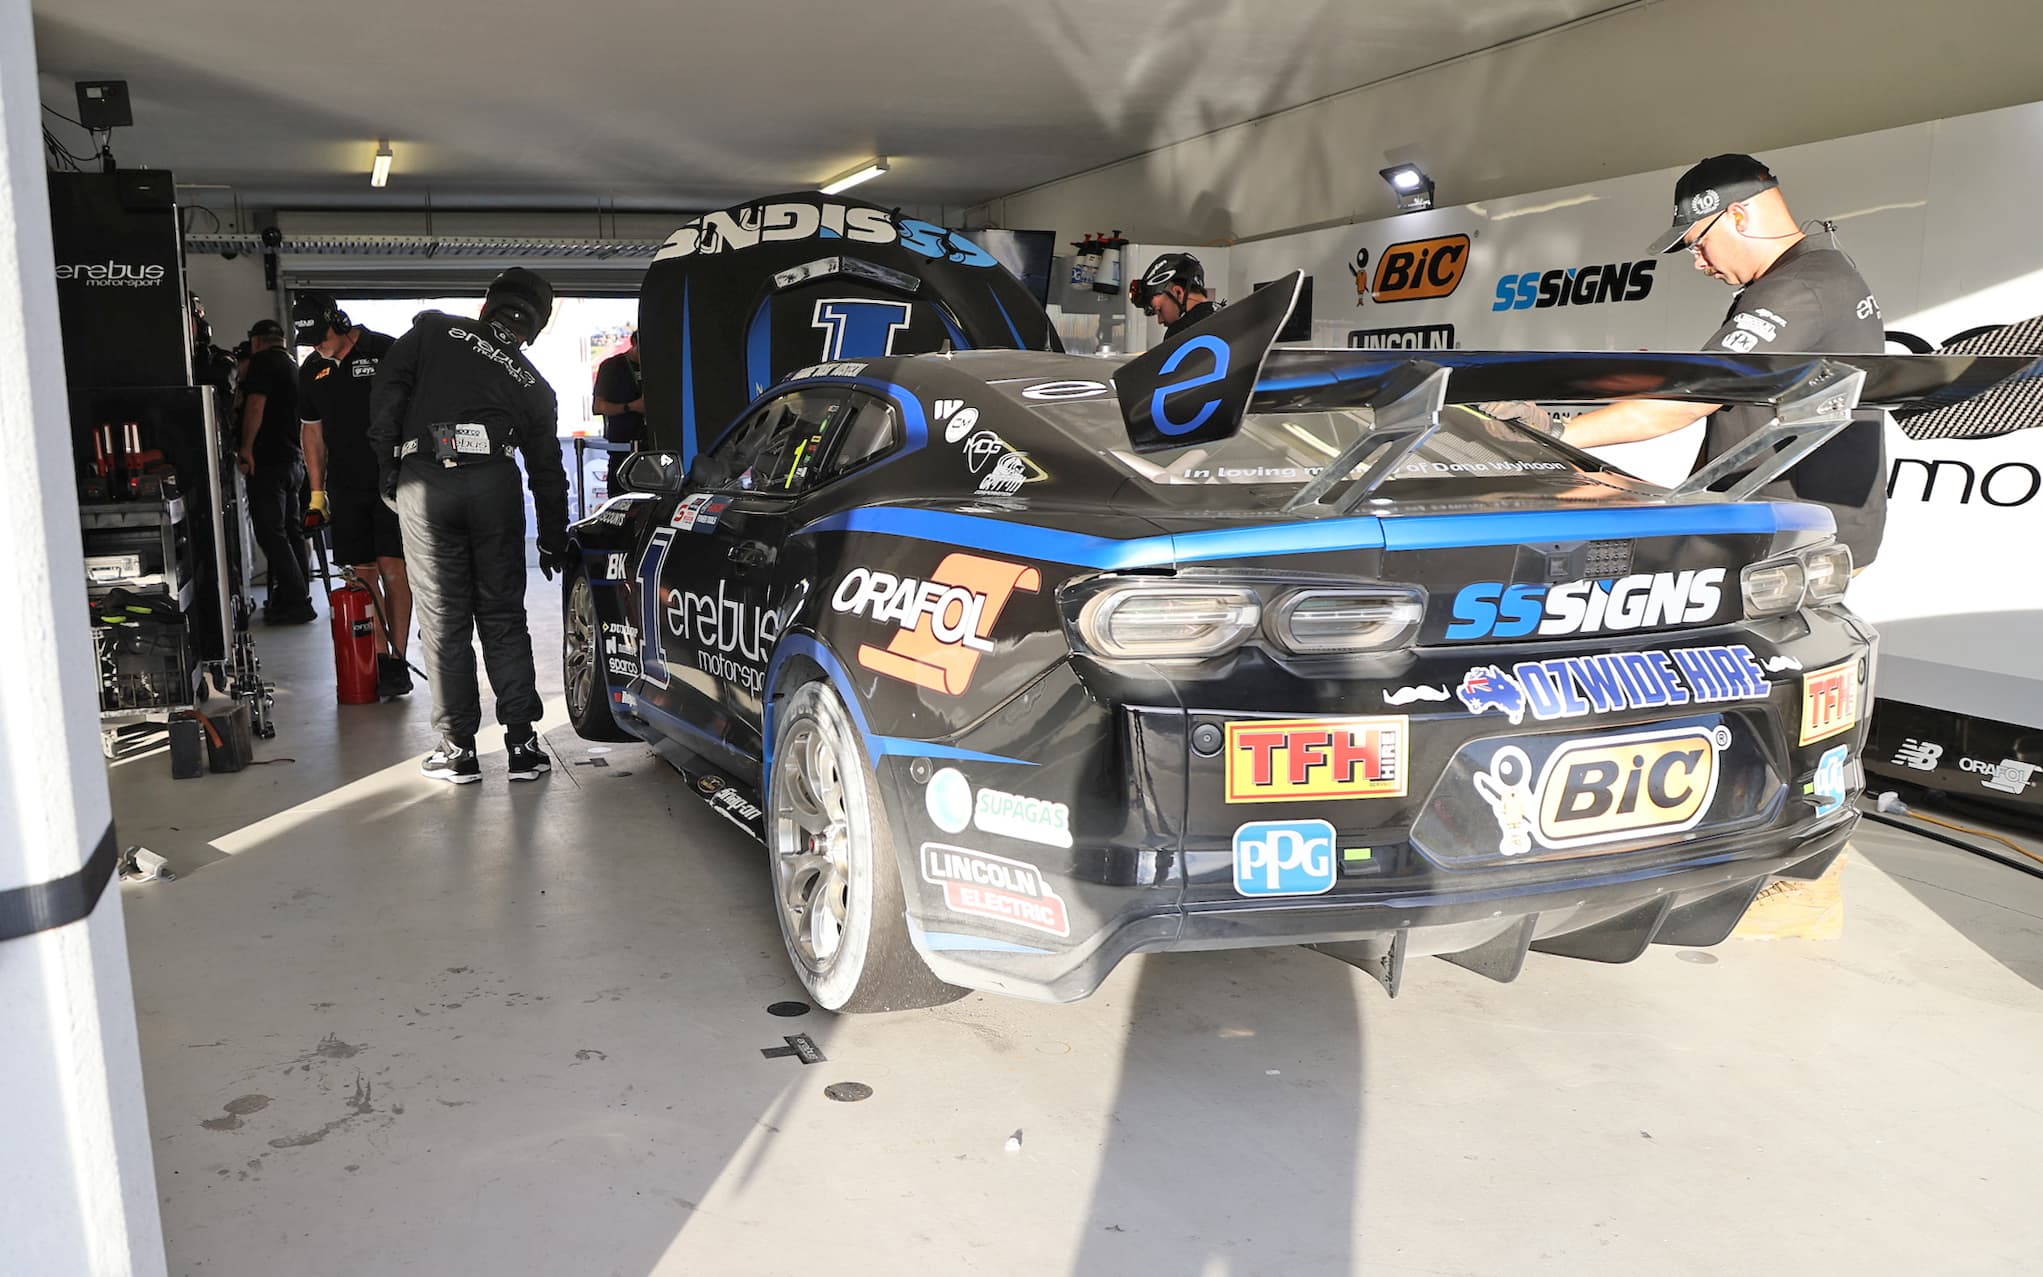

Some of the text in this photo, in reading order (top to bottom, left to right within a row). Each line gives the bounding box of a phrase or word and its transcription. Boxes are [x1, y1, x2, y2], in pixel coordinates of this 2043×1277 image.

[56, 260, 165, 279] erebus
[86, 279, 162, 288] motorsport
[1151, 335, 1231, 437] e
[1184, 468, 1210, 478] In
[1434, 462, 1487, 472] Dana
[832, 568, 995, 653] ORAFOL
[608, 658, 638, 674] sparco
[1675, 645, 1770, 701] HIRE
[1239, 731, 1380, 785] TFH
[980, 794, 1065, 828] SUPAGAS
[930, 851, 1039, 896] LINCOLN
[960, 887, 1055, 926] ELECTRIC
